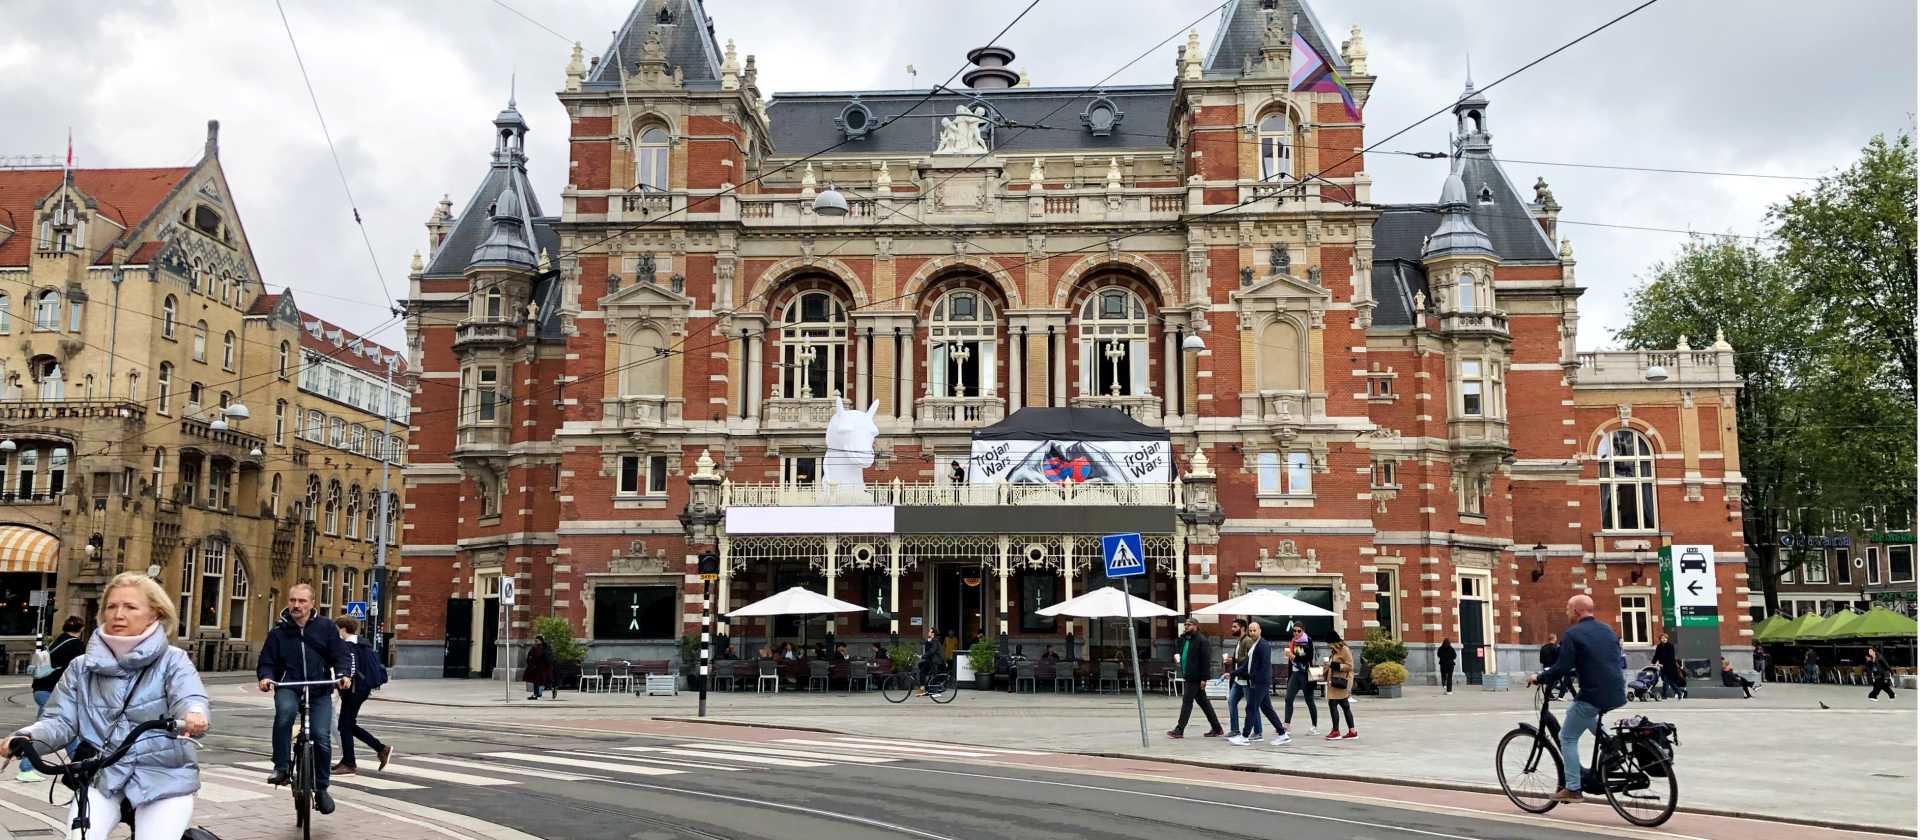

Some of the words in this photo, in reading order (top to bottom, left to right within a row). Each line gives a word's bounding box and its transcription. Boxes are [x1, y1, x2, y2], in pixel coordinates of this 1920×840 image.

[972, 442, 1011, 467] Trojan
[982, 455, 1012, 478] Wars
[1123, 441, 1162, 468] Trojan
[1130, 455, 1163, 479] Wars
[629, 592, 640, 630] ITA
